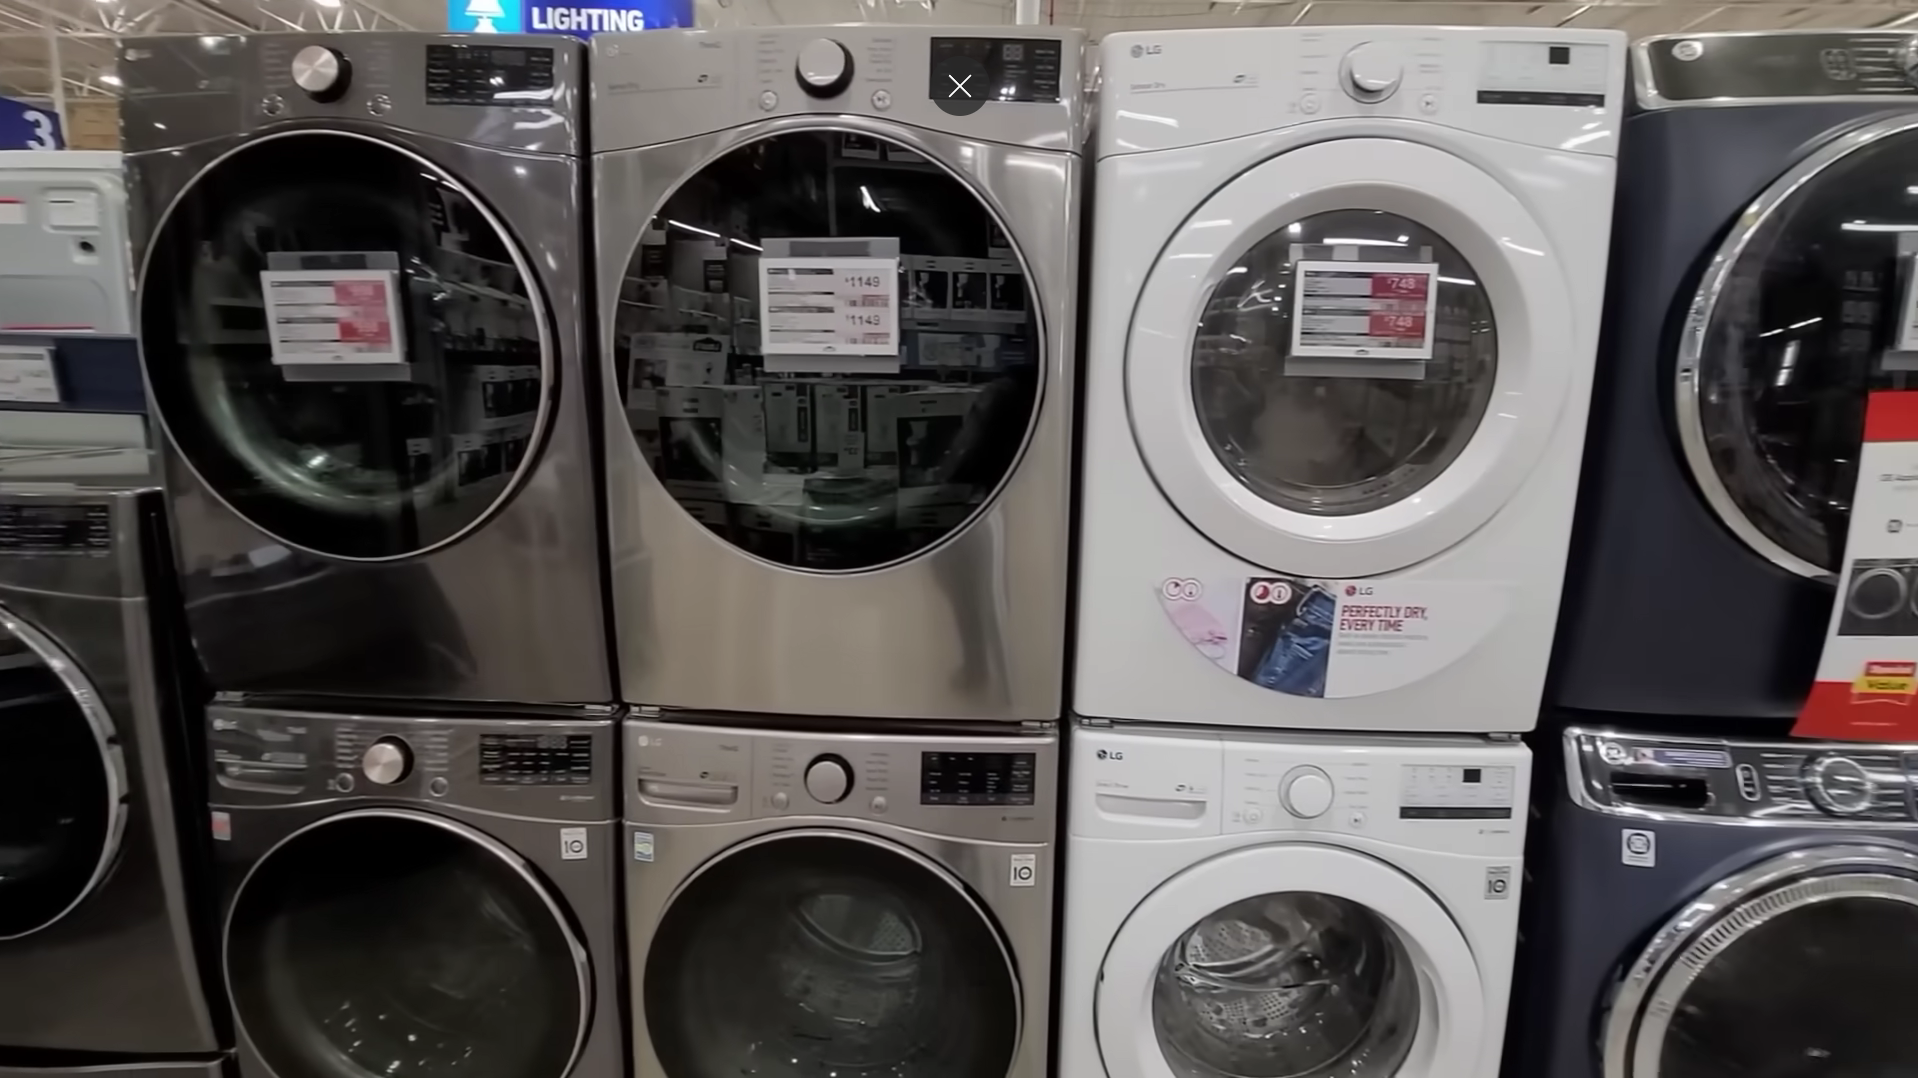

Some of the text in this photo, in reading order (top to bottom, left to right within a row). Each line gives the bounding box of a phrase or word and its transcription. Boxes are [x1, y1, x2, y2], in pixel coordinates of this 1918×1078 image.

[531, 7, 644, 31] LIGHTING
[1146, 45, 1162, 55] LG
[22, 110, 56, 151] 3
[1359, 587, 1374, 596] LG
[1341, 604, 1428, 620] PERFECTLY DRY,
[1339, 618, 1404, 632] EVERY TIME
[1109, 751, 1123, 761] LG
